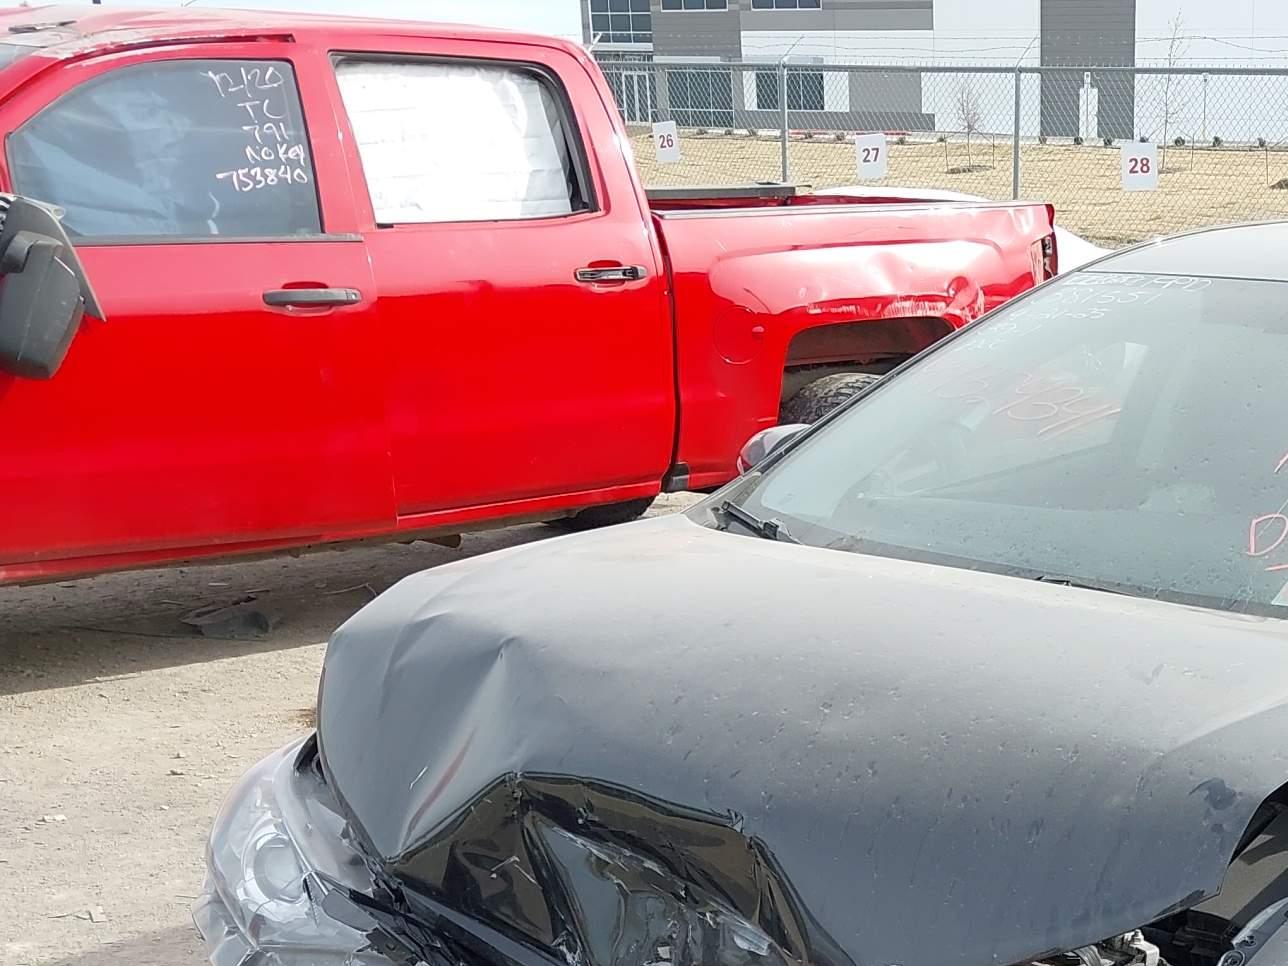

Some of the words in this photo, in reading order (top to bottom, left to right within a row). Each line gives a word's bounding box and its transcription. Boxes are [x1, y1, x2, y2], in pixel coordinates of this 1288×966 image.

[241, 122, 290, 145] 791
[658, 133, 674, 149] 26
[861, 147, 880, 163] 27
[1128, 157, 1151, 174] 28
[215, 164, 308, 191] 753840
